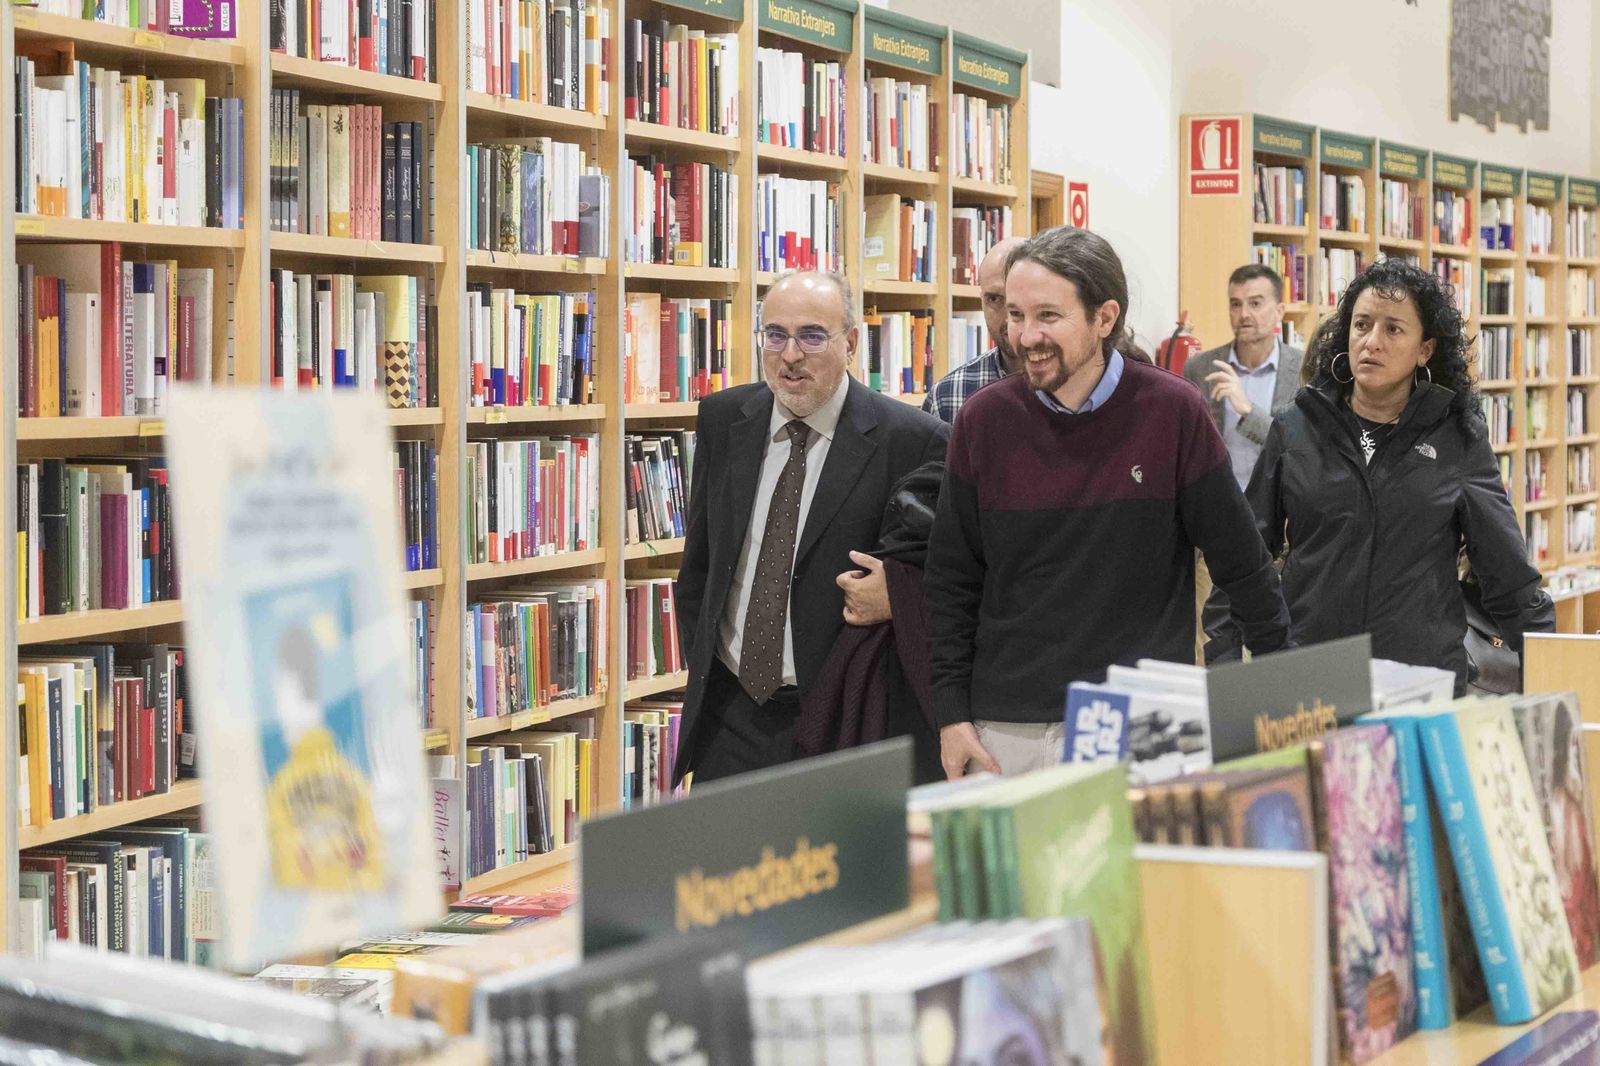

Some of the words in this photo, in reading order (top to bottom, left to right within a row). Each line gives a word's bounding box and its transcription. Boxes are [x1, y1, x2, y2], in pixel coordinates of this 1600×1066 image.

[768, 1, 800, 27] Narrativa
[801, 12, 836, 38] Extranjera
[873, 33, 900, 55] Narrativa
[900, 39, 930, 64] Extranjera
[958, 56, 983, 77] Narrativa
[983, 62, 1009, 85] Extranjera
[1195, 179, 1234, 188] EXTINTOR
[124, 313, 134, 396] LITERATURA
[1254, 698, 1338, 753] Novedades
[674, 836, 840, 932] Novedades
